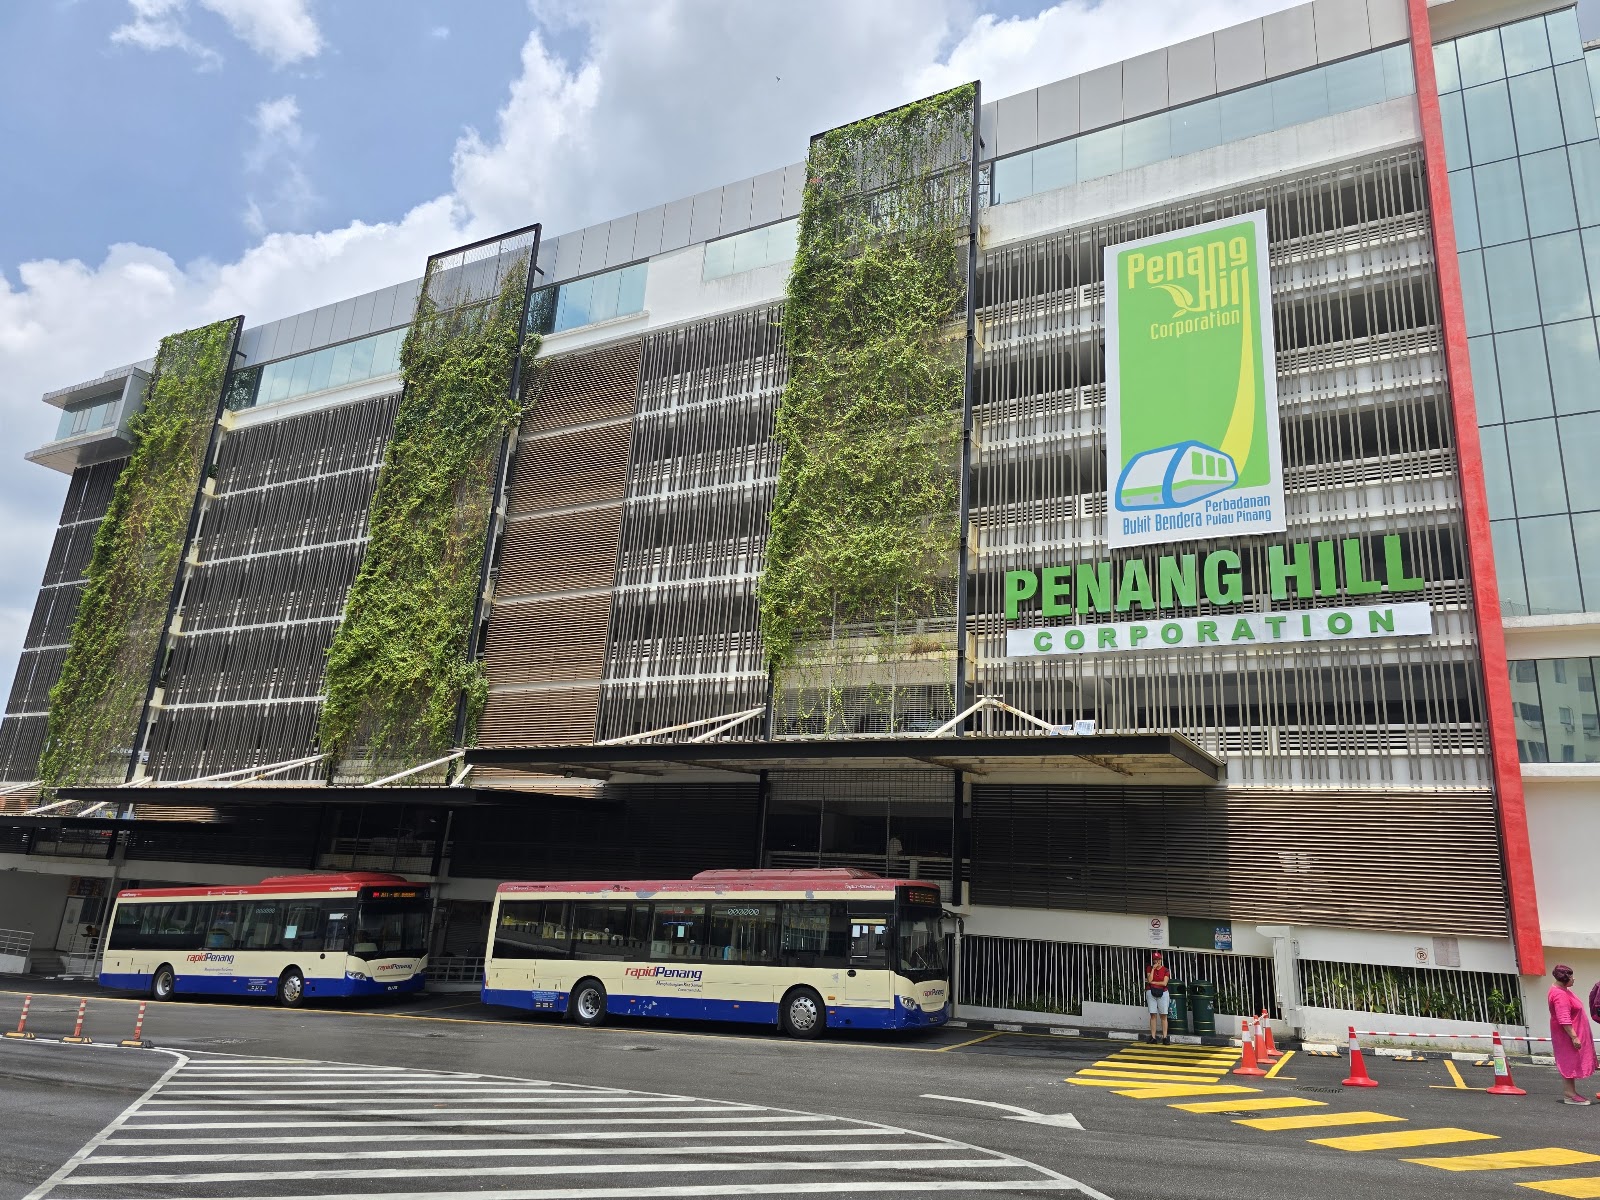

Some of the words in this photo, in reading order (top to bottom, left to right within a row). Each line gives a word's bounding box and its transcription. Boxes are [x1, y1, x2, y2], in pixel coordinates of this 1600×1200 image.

[1127, 236, 1248, 289] Penang
[1198, 266, 1249, 312] Hill
[1150, 309, 1240, 340] Corporation
[1205, 495, 1271, 512] Perbadanan
[1123, 514, 1151, 535] Bukit
[1155, 511, 1203, 532] Bendera
[1206, 512, 1234, 526] Pulau
[1236, 509, 1272, 523] Pinang
[1005, 549, 1243, 621] PENANG
[1268, 534, 1425, 601] HILL
[1033, 608, 1396, 652] CORPORATION
[186, 952, 235, 965] rapidPenang
[625, 966, 703, 982] rapidPenang
